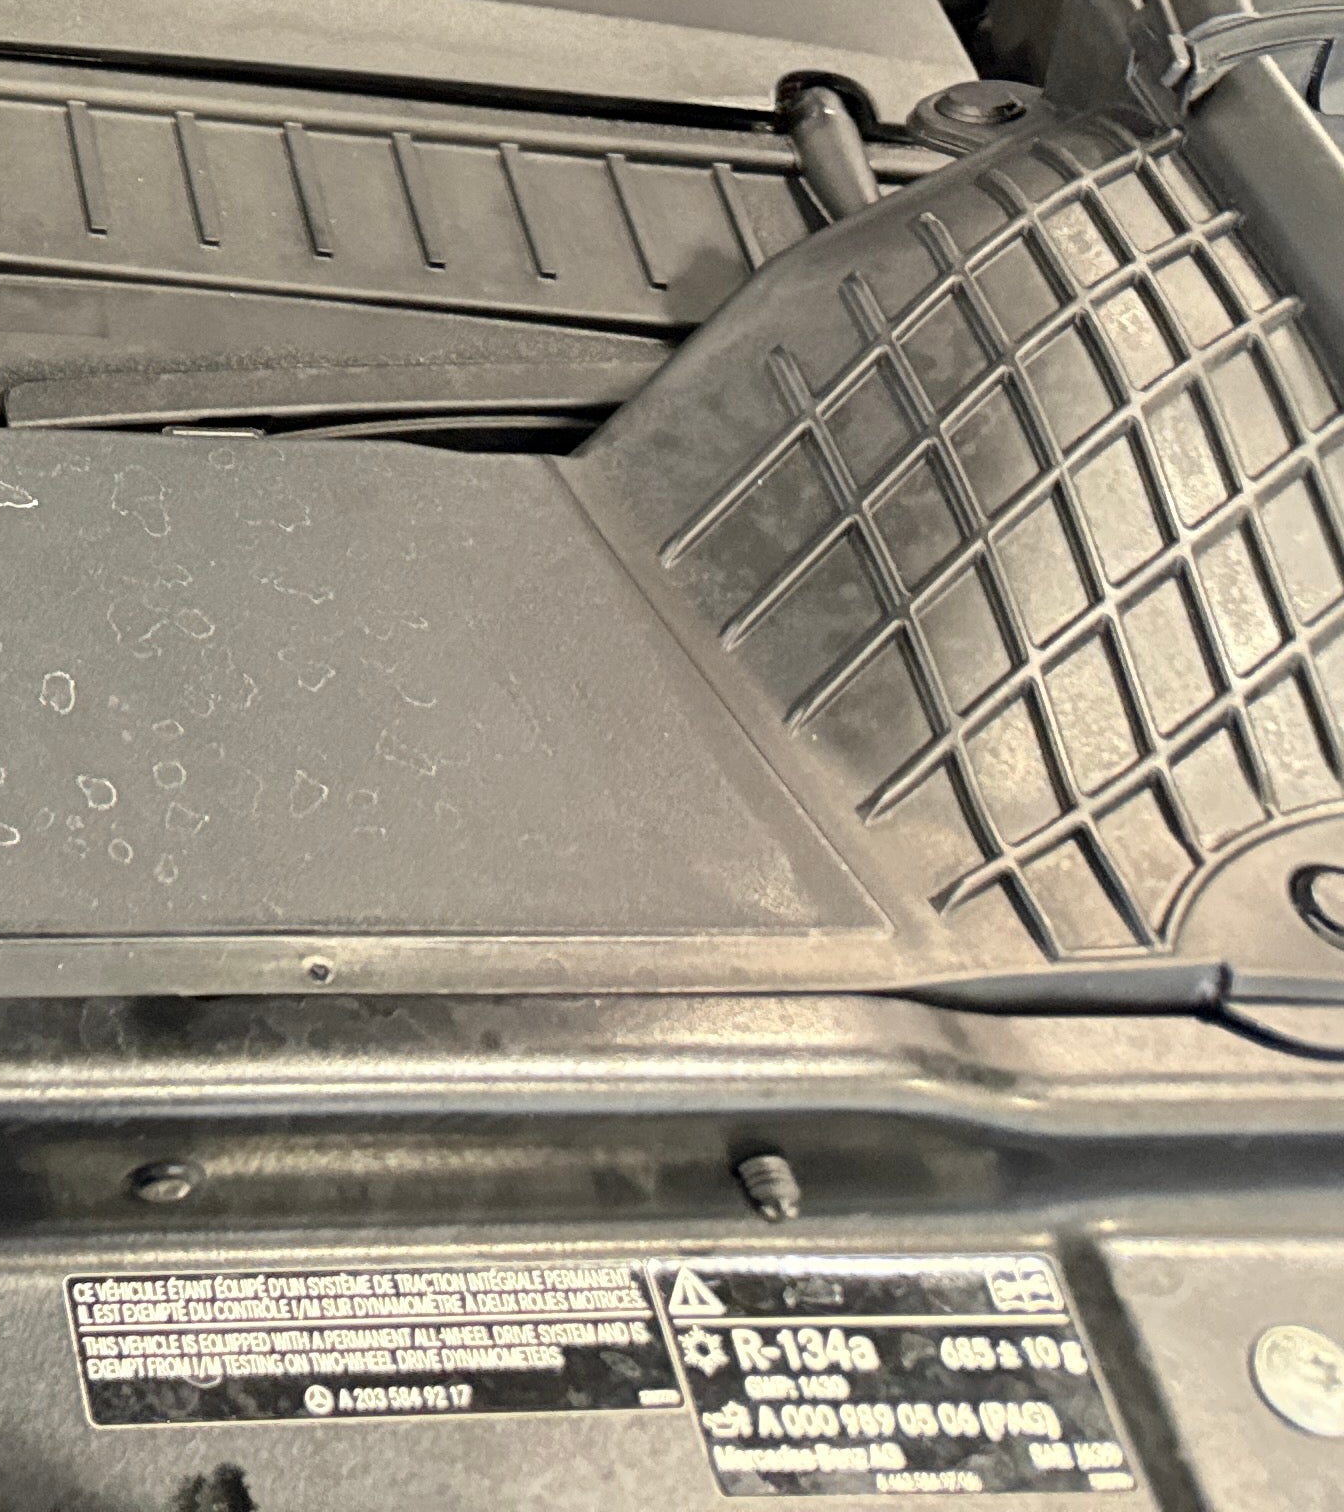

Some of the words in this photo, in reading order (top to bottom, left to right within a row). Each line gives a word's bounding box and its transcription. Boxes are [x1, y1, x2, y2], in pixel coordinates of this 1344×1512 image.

[73, 1282, 96, 1303] CE
[96, 1278, 167, 1302] VÉHICULE
[168, 1276, 213, 1300] ÉTANT
[215, 1275, 267, 1299] ÉQUIPÉ
[268, 1276, 306, 1297] D'UN
[307, 1272, 371, 1295] SYSTÈME
[373, 1273, 395, 1293] DE
[396, 1271, 466, 1293] TRACTION
[467, 1268, 544, 1291] INTÉGRALE
[78, 1305, 93, 1324] IL
[93, 1303, 121, 1323] EST
[122, 1300, 188, 1322] EXEMPTÉ
[189, 1302, 213, 1320] DU
[214, 1297, 290, 1320] CONTRÔLE
[291, 1299, 320, 1319] I/M
[321, 1297, 354, 1317] SUR
[355, 1291, 463, 1315] DYNAMOMÈTRE
[465, 1290, 478, 1313] À
[478, 1291, 517, 1312] DEUX
[518, 1291, 568, 1311] ROUES
[82, 1336, 117, 1356] THIS
[118, 1335, 181, 1355] VEHICLE
[182, 1334, 198, 1354] IS
[199, 1332, 270, 1353] EQUIPPED
[271, 1331, 310, 1351] WITH
[311, 1331, 325, 1350] A
[326, 1327, 412, 1350] PERMANENT
[414, 1324, 492, 1347] ALL-WHEEL
[493, 1322, 538, 1344] DRIVE
[538, 1322, 597, 1344] SYSTEM
[598, 1321, 629, 1343] AND
[629, 1321, 649, 1343] IS
[730, 1328, 880, 1372] R-134a
[940, 1336, 997, 1371] 685
[1021, 1335, 1061, 1369] 10
[87, 1358, 146, 1379] EXEMPT
[146, 1357, 191, 1378] FROM
[192, 1356, 222, 1377] I/M
[223, 1354, 283, 1376] TESTING
[284, 1353, 310, 1373] ON
[311, 1350, 396, 1374] TWO-WHEEL
[397, 1347, 441, 1371] DRIVE
[338, 1389, 354, 1411] A
[355, 1387, 389, 1410] 203
[389, 1386, 424, 1408] 584
[424, 1385, 448, 1407] 92
[449, 1384, 472, 1407] 17
[758, 1404, 784, 1437] A
[781, 1404, 840, 1437] 000
[839, 1403, 895, 1437] 989
[896, 1403, 938, 1437] 05
[938, 1402, 980, 1437] 06
[979, 1401, 1061, 1442] (PAG)
